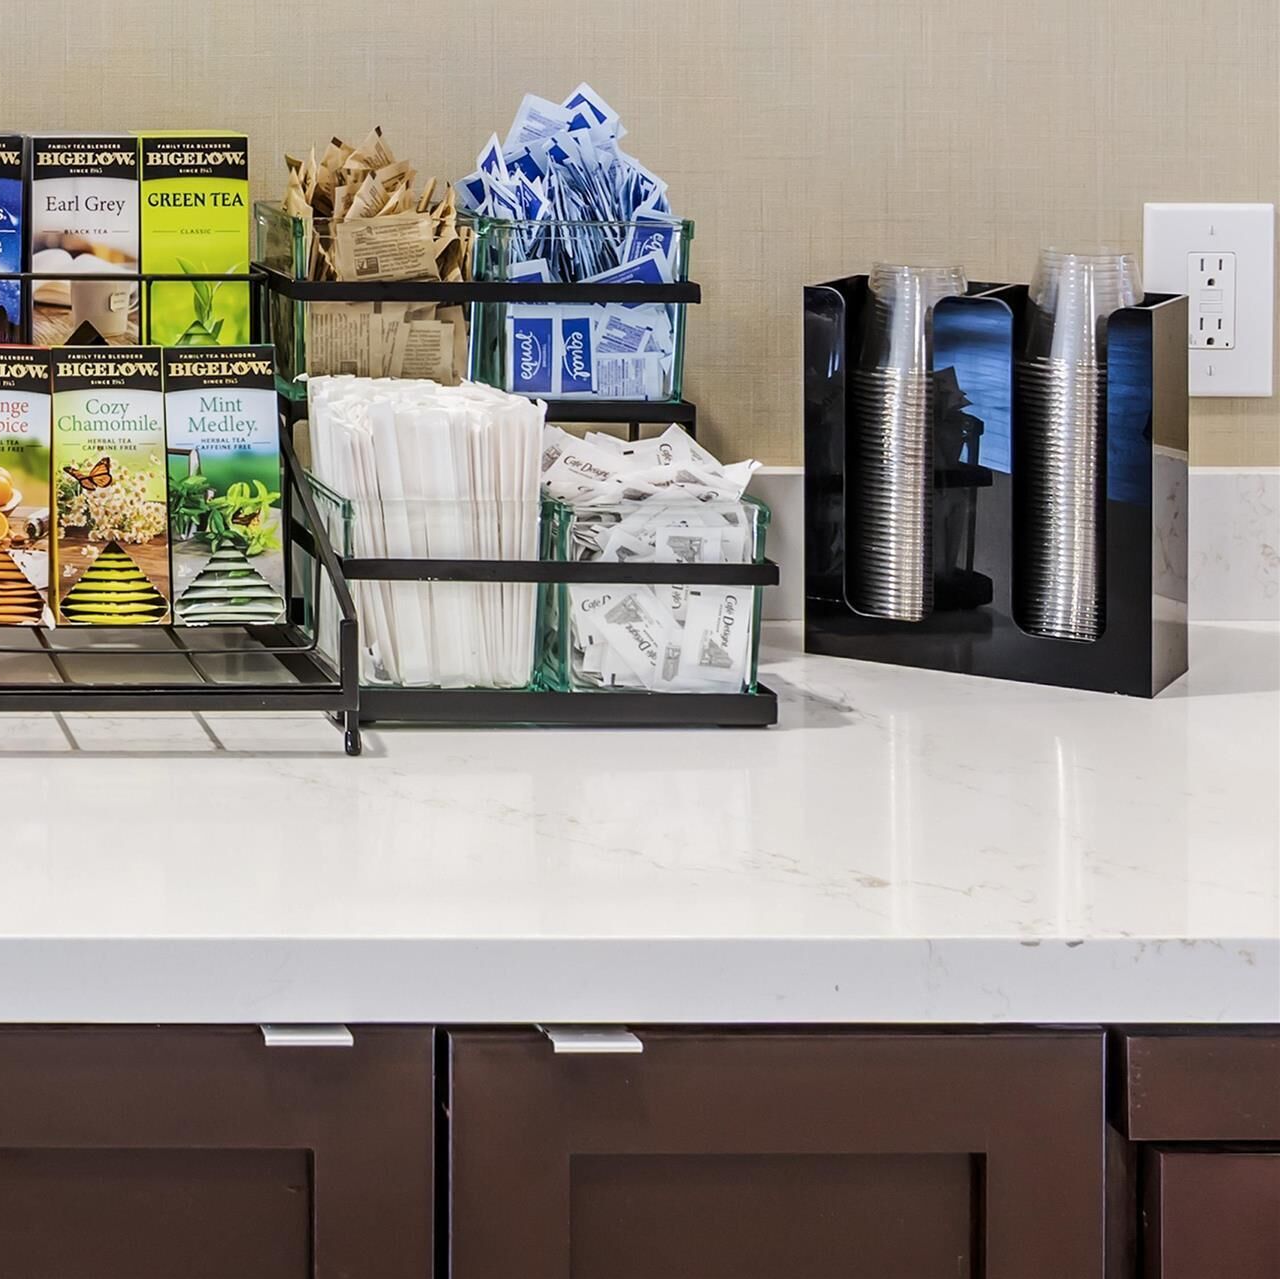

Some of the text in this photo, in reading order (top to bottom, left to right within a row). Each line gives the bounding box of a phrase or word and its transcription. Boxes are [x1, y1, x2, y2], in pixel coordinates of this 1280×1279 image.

[46, 195, 126, 216] Earl Grey
[147, 192, 244, 207] GREEN TEA
[515, 331, 538, 381] equal
[566, 331, 591, 381] equal
[85, 398, 130, 419] Cozy
[199, 396, 242, 413] Mint
[57, 414, 158, 432] Chamomile
